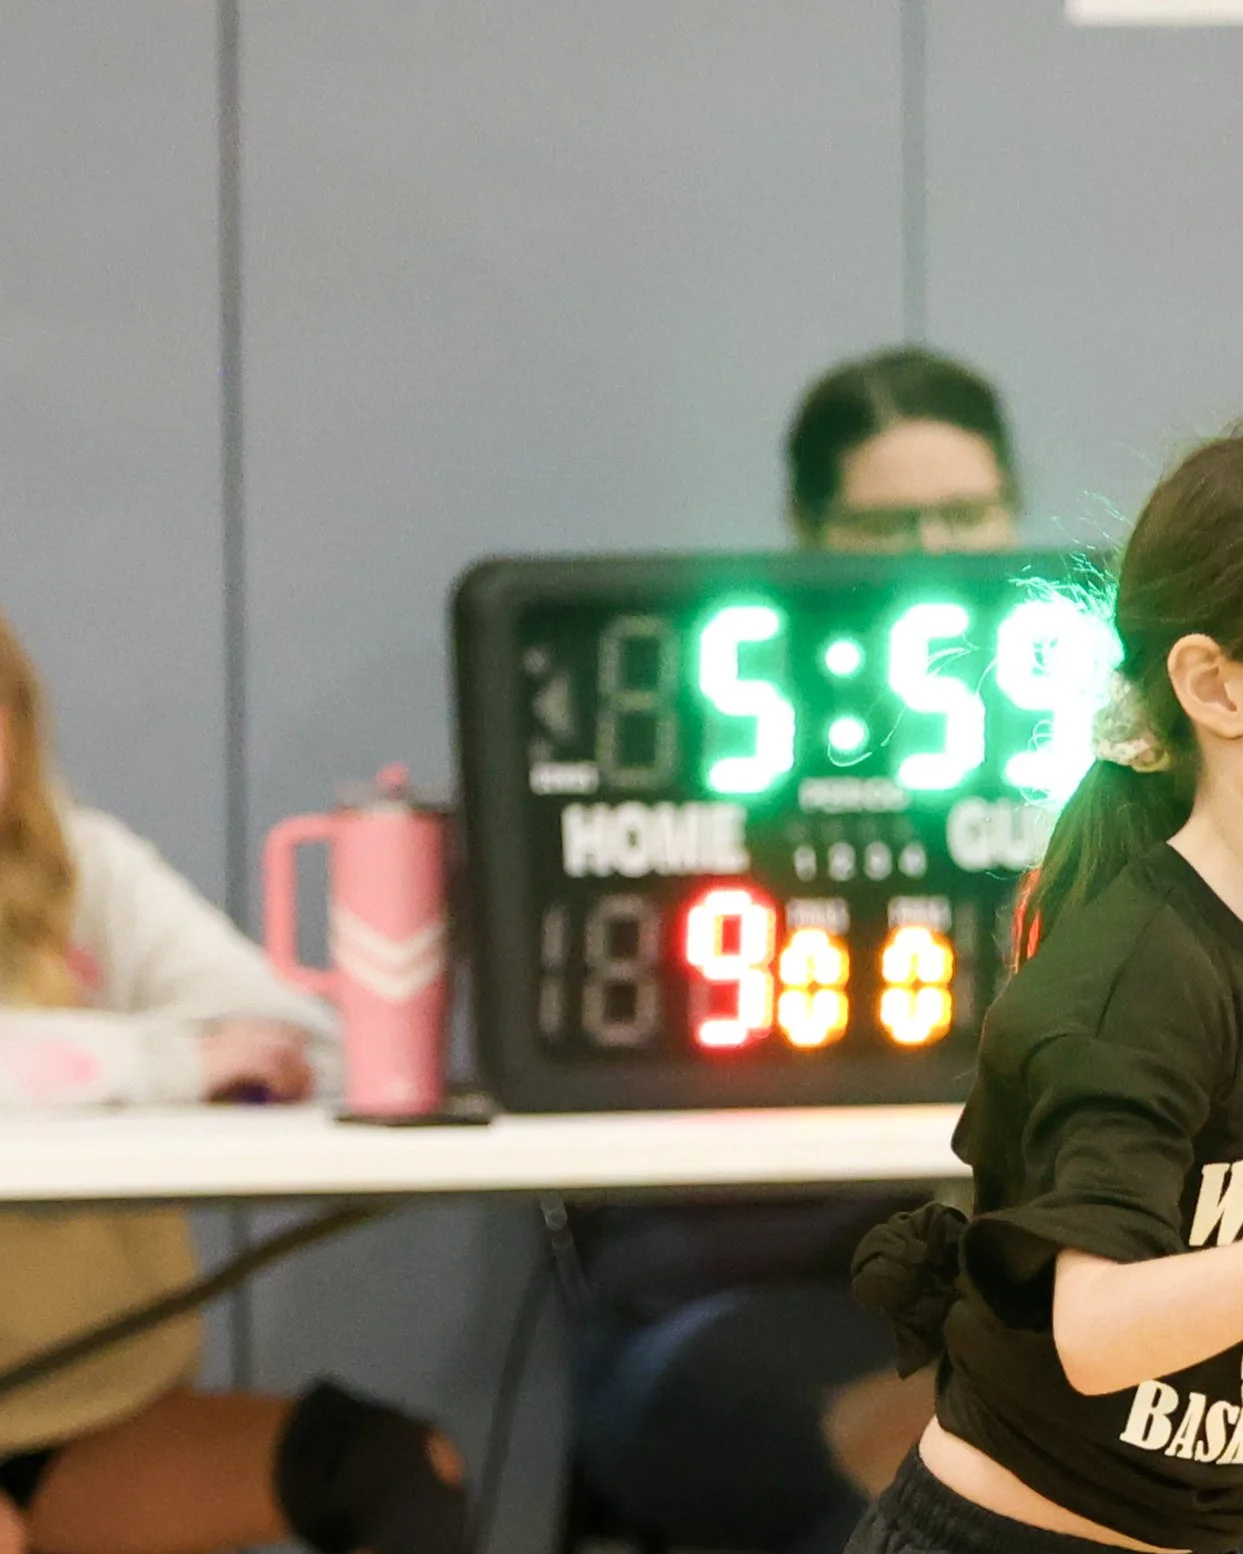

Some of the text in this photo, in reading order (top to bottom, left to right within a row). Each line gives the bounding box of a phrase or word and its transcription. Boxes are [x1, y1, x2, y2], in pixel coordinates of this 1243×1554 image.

[697, 602, 1112, 795] 5:59
[561, 801, 750, 876] HOME
[684, 888, 777, 1048] 9
